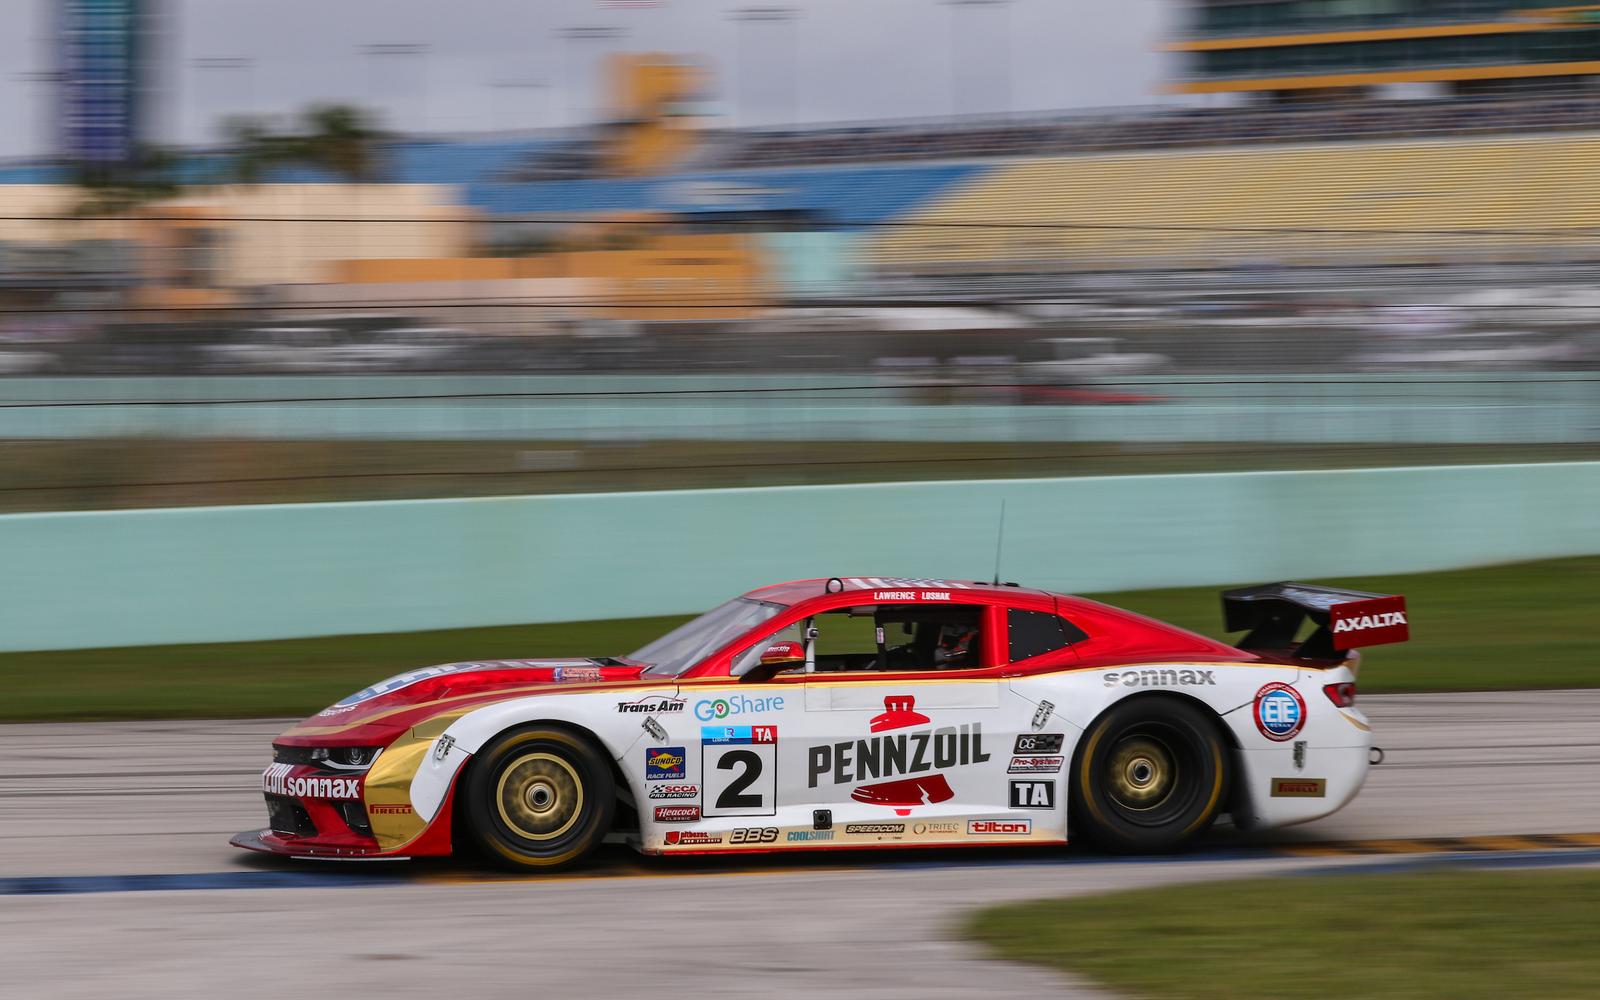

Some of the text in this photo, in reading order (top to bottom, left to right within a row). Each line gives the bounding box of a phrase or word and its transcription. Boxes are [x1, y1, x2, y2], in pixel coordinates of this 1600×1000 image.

[873, 591, 951, 600] LAWRENCE LOSHAK
[1333, 611, 1407, 633] AXALTA
[1103, 669, 1216, 688] sonnax
[617, 700, 684, 713] Trans Am
[755, 728, 773, 742] TA
[1019, 738, 1036, 749] CG
[649, 757, 682, 765] SUNOCO
[808, 722, 991, 788] PENNZOIL
[715, 750, 763, 808] 2
[287, 777, 360, 799] sonnax
[665, 785, 697, 793] SCCA
[1015, 783, 1050, 806] TA
[370, 804, 412, 814] PIRELLI
[656, 807, 698, 817] Heacock
[847, 824, 904, 833] SPEEDCOM
[972, 822, 1027, 833] tilton
[730, 827, 779, 844] BBS
[787, 831, 835, 841] COOLSHIRT
